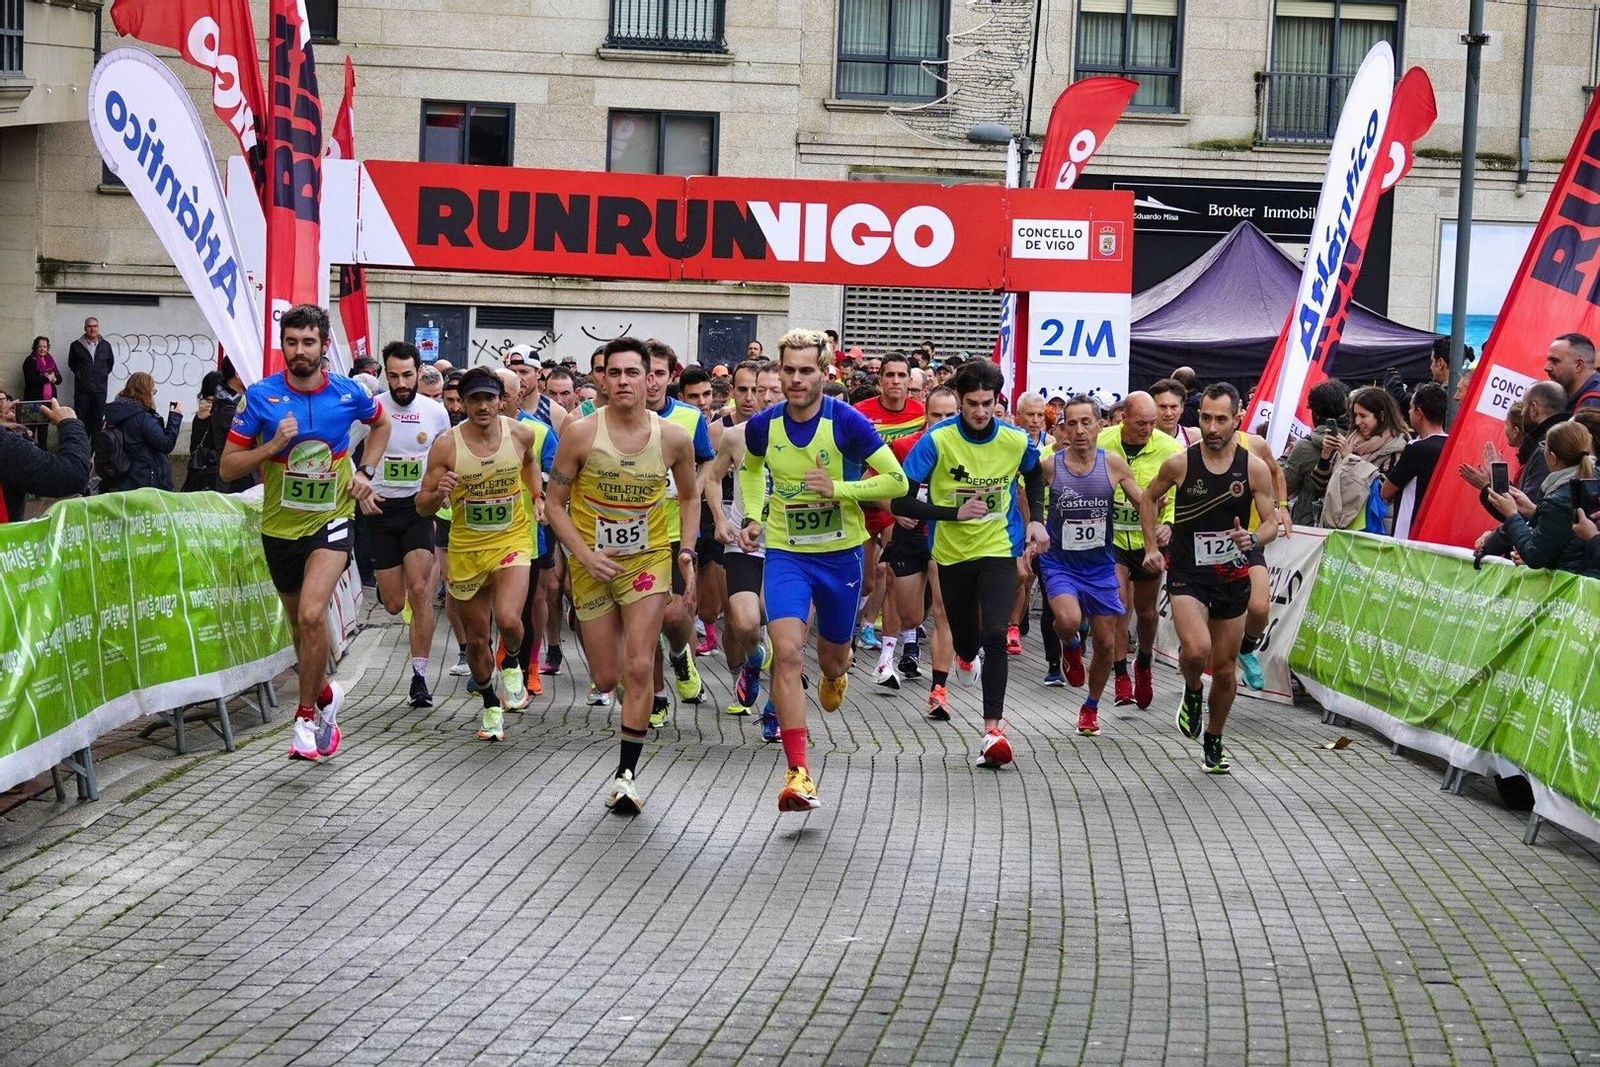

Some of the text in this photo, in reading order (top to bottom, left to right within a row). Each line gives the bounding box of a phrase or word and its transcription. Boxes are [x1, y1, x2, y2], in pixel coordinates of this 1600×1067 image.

[1163, 213, 1179, 221] Misa
[1208, 204, 1256, 217] Broker
[1018, 227, 1083, 239] CONCELLO
[1299, 109, 1378, 361] Atlántico
[1025, 240, 1075, 251] DE VIGO
[1491, 376, 1525, 398] CONC
[1492, 394, 1510, 410] DE
[390, 463, 419, 477] 514
[291, 481, 330, 499] 517
[464, 477, 516, 491] ATHLETICS
[596, 482, 654, 495] ATHLETICS
[775, 481, 807, 492] GrupoR
[603, 492, 618, 501] San
[1061, 497, 1108, 508] castrelos
[472, 506, 506, 521] 519
[795, 509, 834, 530] 597
[604, 525, 640, 544] 185
[1075, 527, 1095, 540] 30
[1203, 538, 1235, 554] 122
